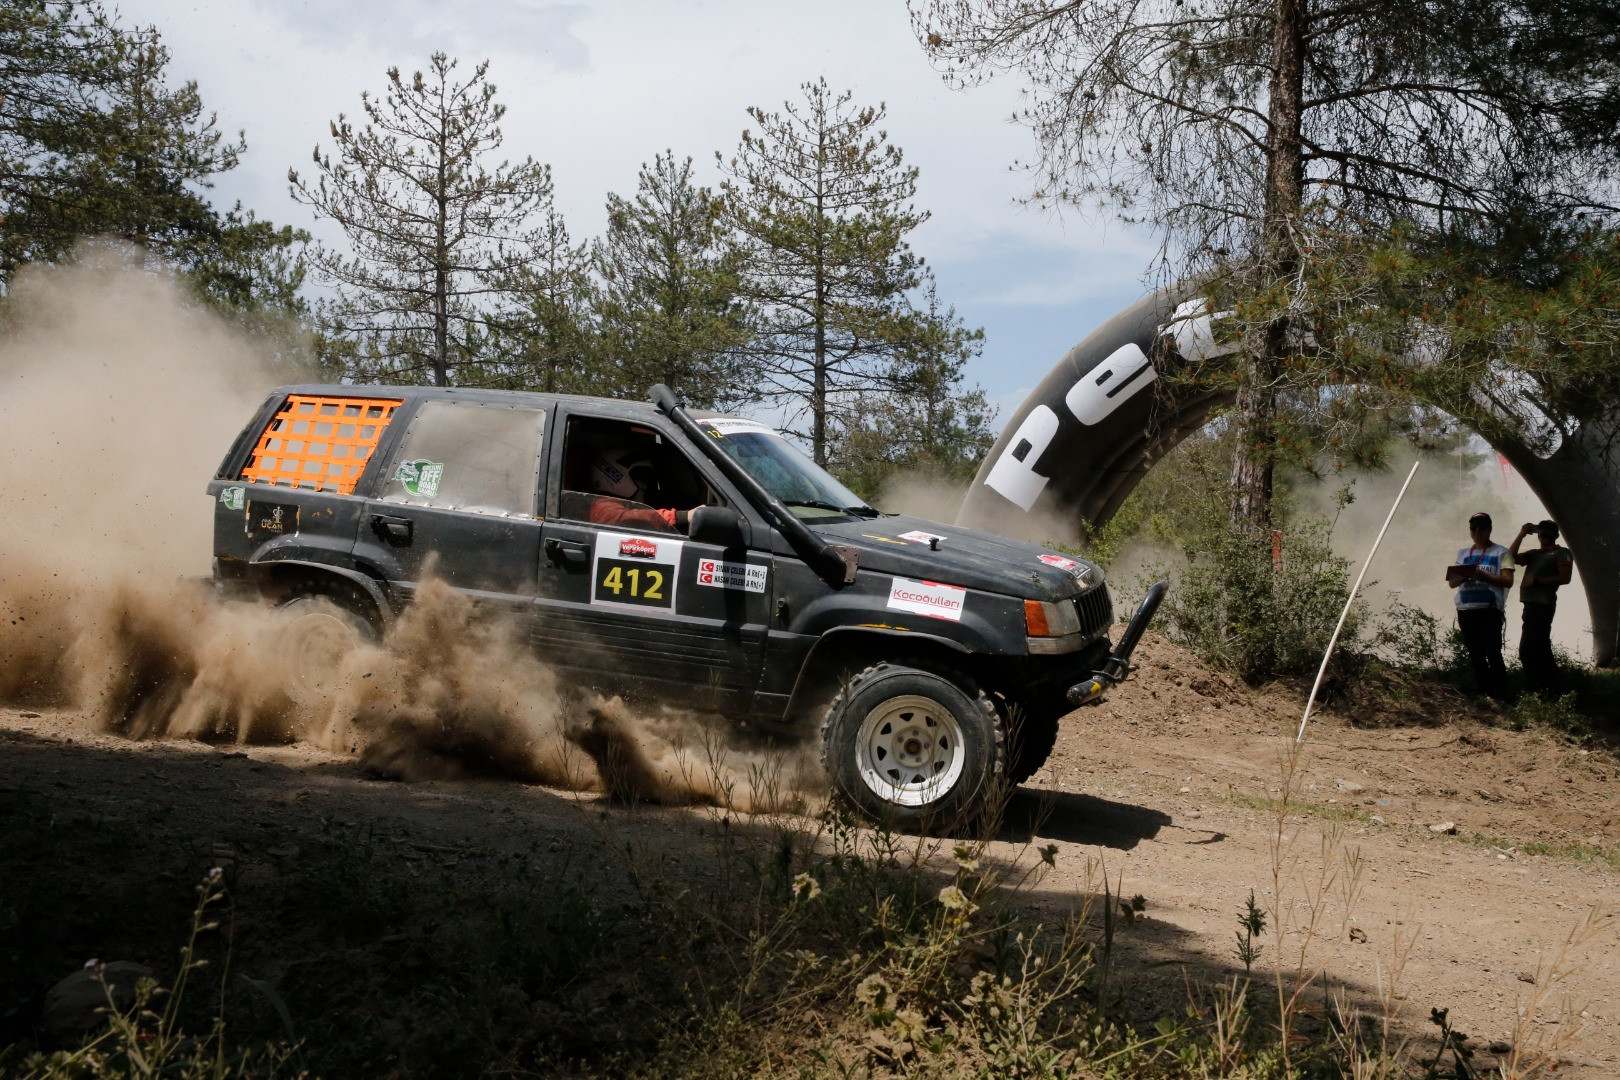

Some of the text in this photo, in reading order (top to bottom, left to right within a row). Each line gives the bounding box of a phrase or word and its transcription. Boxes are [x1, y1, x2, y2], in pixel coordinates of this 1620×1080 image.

[420, 470, 440, 482] OFF
[747, 568, 752, 576] A
[603, 566, 663, 600] 412
